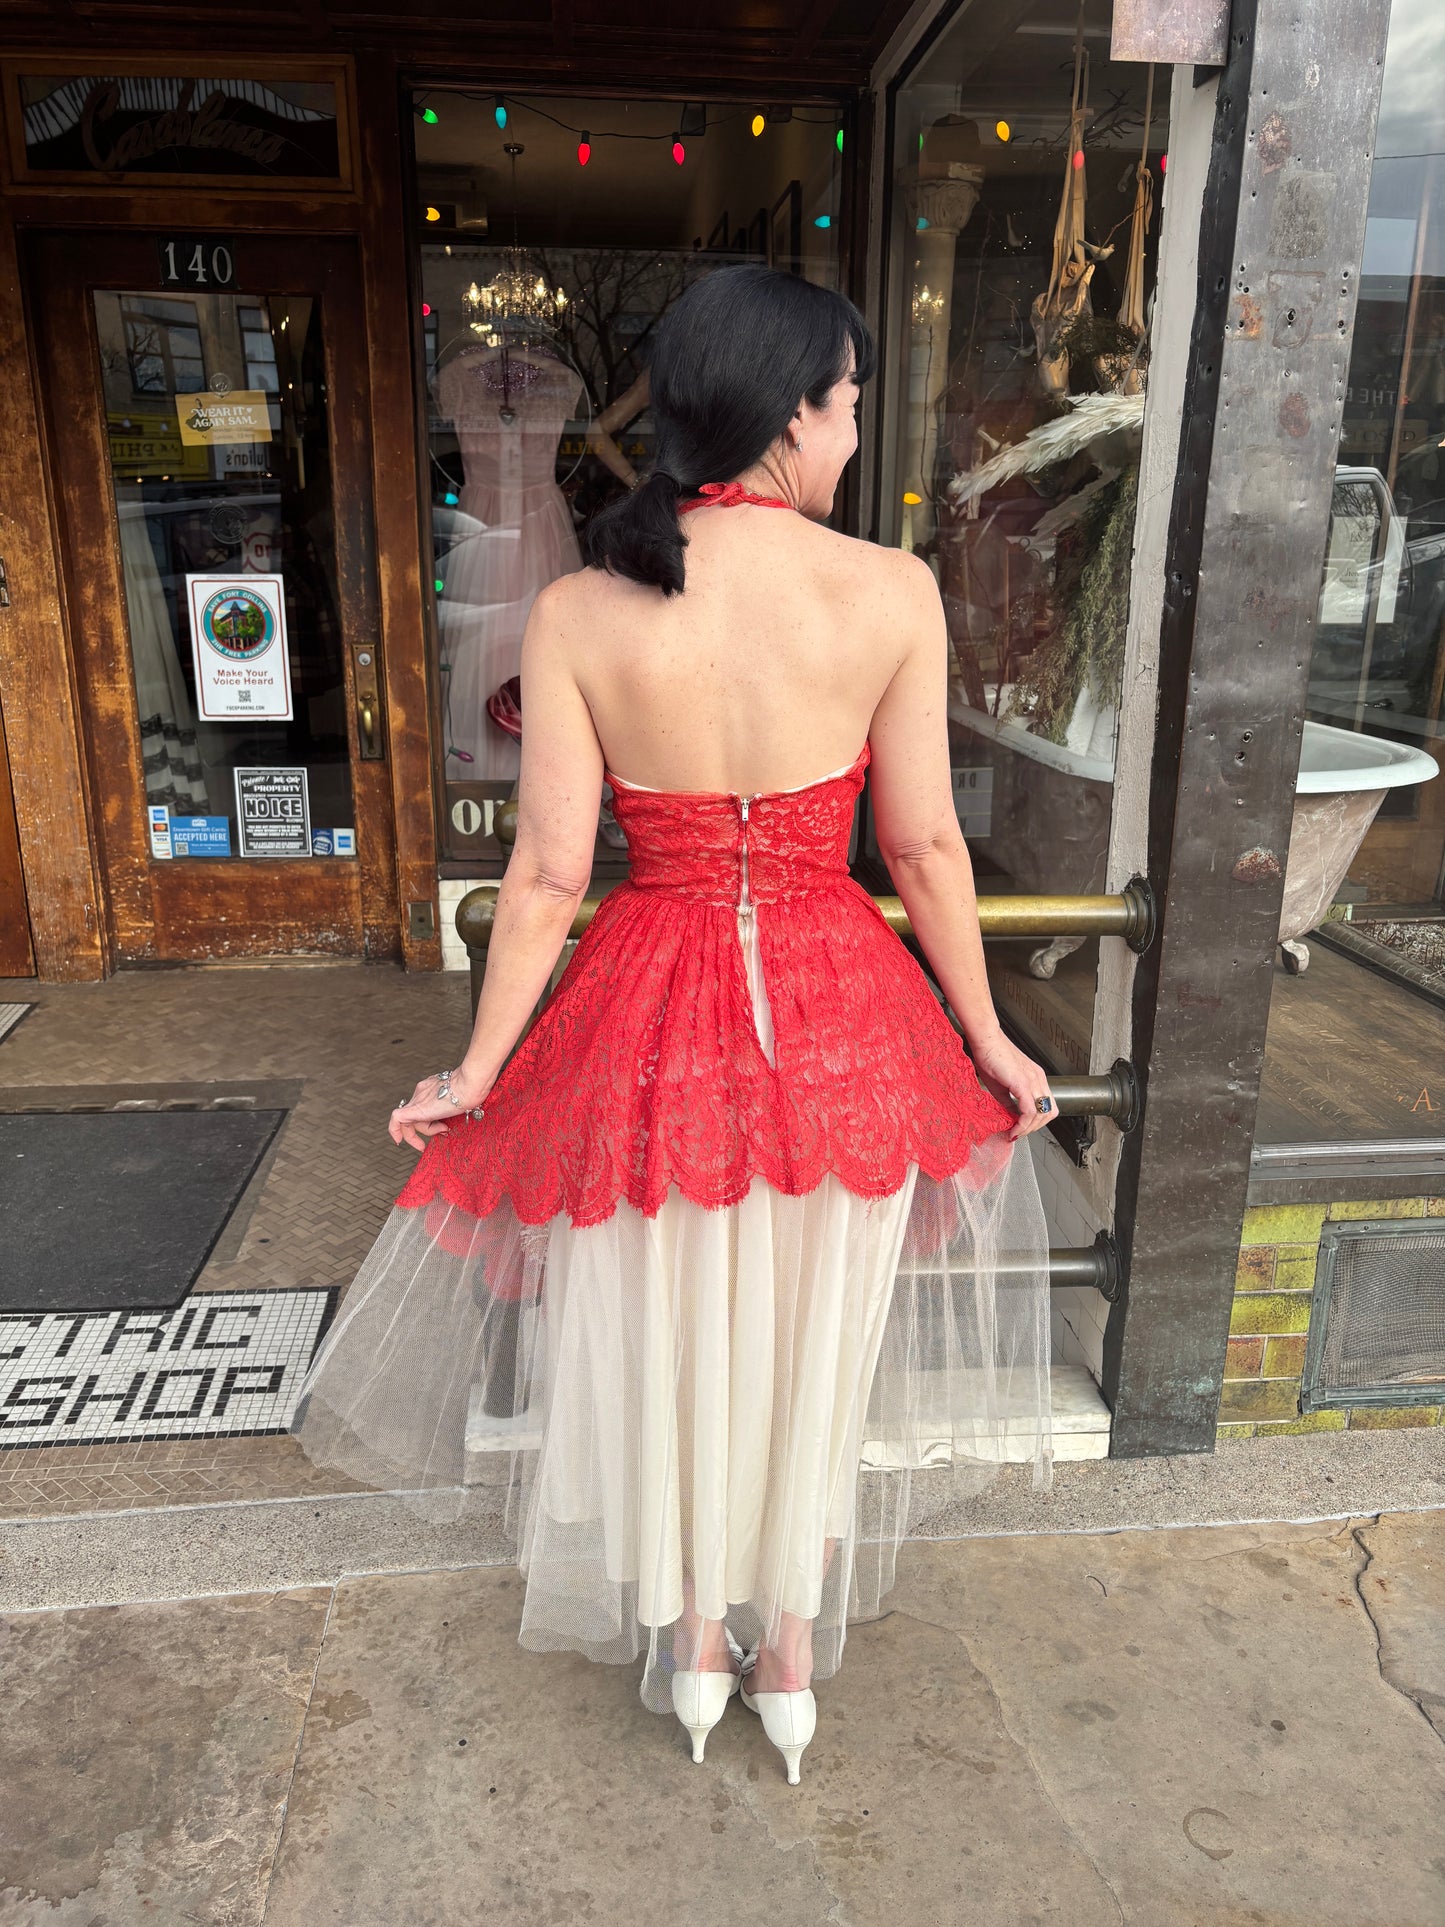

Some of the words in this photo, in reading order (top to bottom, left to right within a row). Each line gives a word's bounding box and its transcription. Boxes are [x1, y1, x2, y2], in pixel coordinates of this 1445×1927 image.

[80, 78, 286, 171] Casablanca
[164, 241, 233, 284] 140
[190, 407, 231, 418] WEAR
[233, 406, 245, 416] IT
[192, 417, 225, 428] AGAIN
[217, 669, 243, 677] Make
[246, 669, 268, 677] Your
[213, 677, 241, 686] Voice
[244, 677, 274, 685] Heard
[253, 784, 301, 793] PROPERTY
[244, 797, 270, 818] NO
[174, 832, 208, 841] ACCEPTED
[209, 832, 228, 841] HERE
[1025, 991, 1045, 1032] THE
[1047, 1016, 1089, 1074] SENSES
[0, 1365, 288, 1429] SHOP
